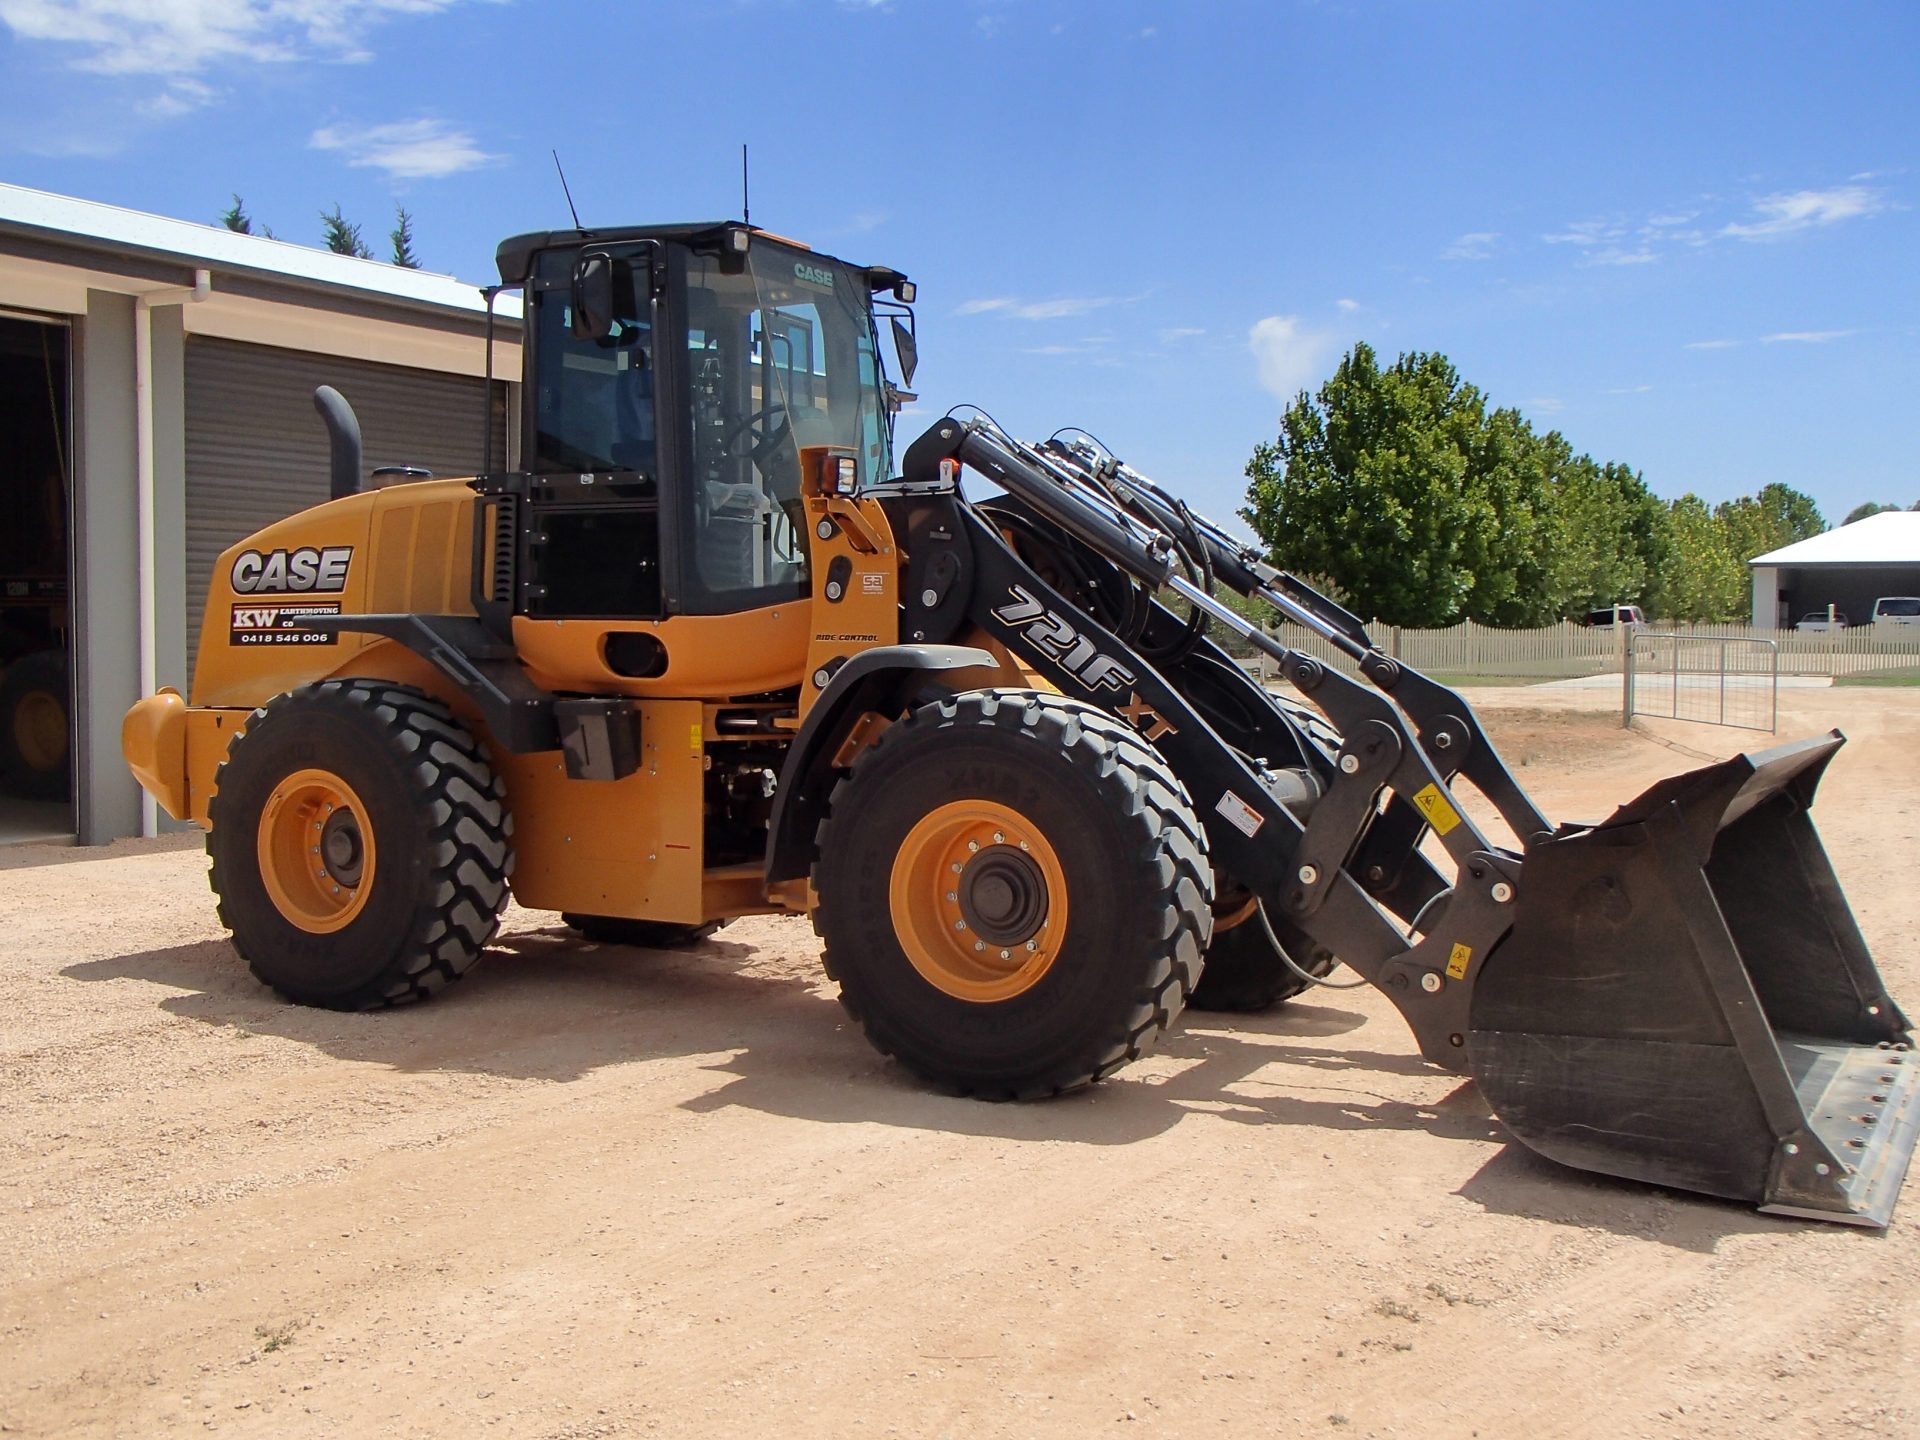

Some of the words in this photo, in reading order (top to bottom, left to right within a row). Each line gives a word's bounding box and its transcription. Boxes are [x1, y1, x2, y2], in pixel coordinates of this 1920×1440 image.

[794, 263, 833, 287] CASE
[232, 549, 351, 593] CASE
[233, 609, 278, 628] KW
[280, 607, 338, 615] EARTHMOVING
[241, 634, 272, 642] 0418
[276, 634, 299, 642] 546
[303, 634, 328, 642] 006
[990, 583, 1137, 692] 721F
[1114, 690, 1179, 743] XT
